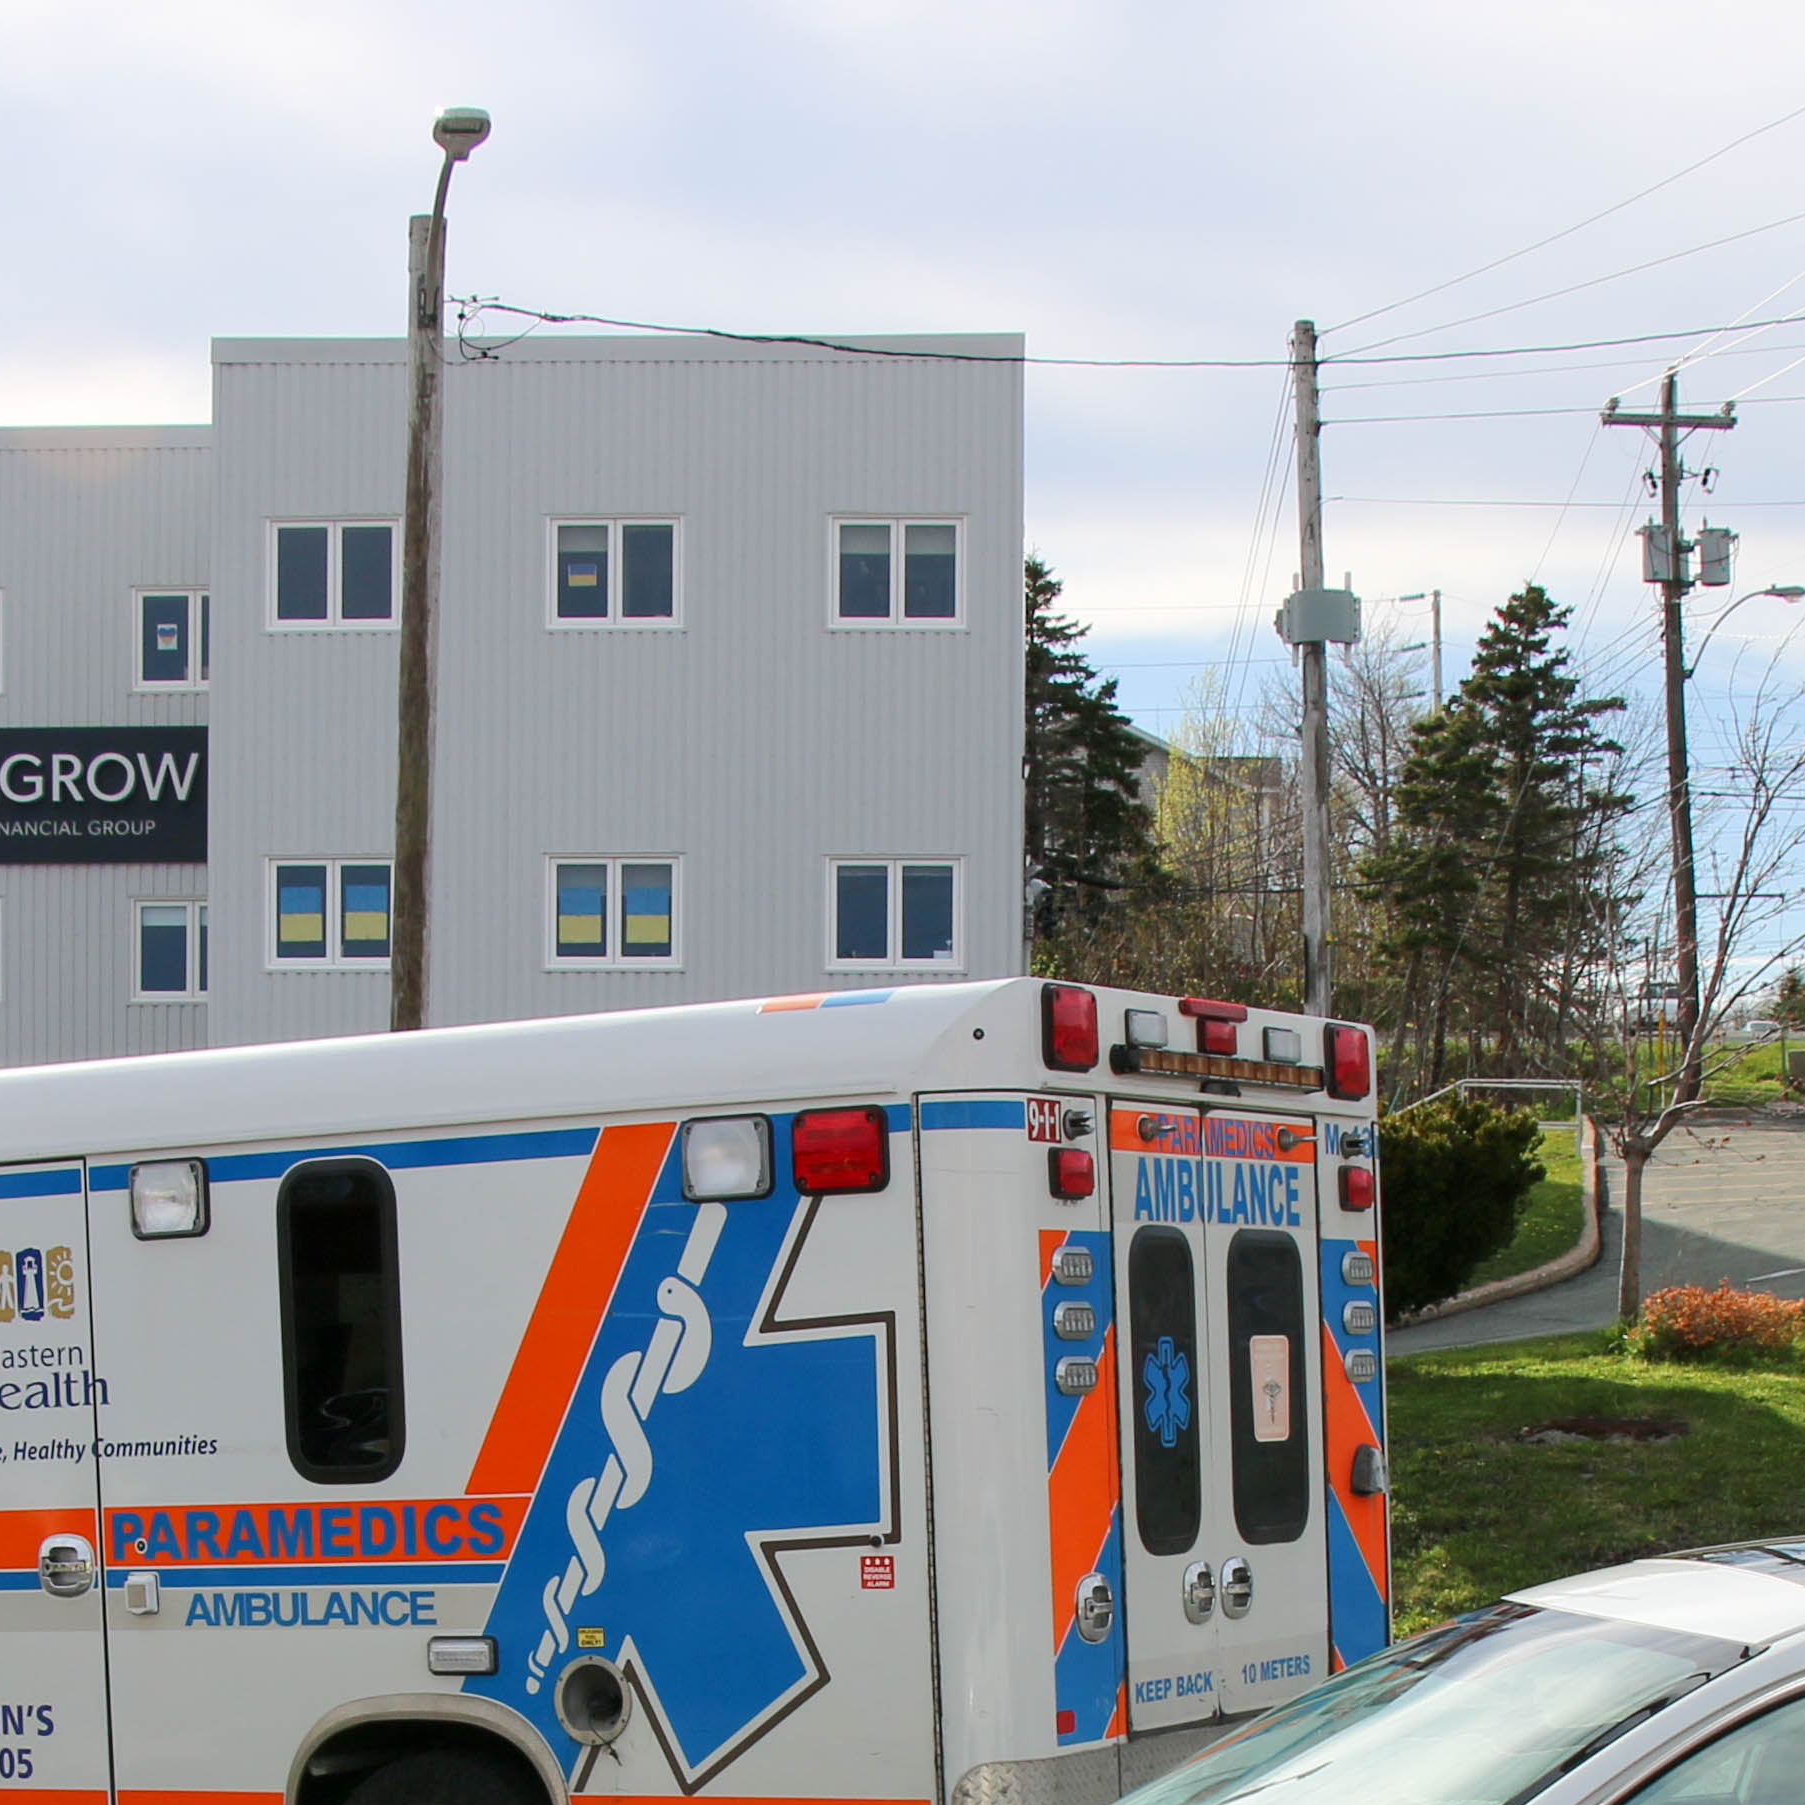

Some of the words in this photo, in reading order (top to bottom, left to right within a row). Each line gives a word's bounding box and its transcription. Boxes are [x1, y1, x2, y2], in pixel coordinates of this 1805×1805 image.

[88, 820, 156, 836] GROUP
[1029, 1101, 1060, 1140] 9-1-1
[1134, 1157, 1300, 1226] AMBULANCE
[14, 1439, 86, 1463] Healthy
[93, 1435, 218, 1459] Communities
[111, 1503, 505, 1561] PARAMEDICS
[185, 1591, 437, 1627] AMBULANCE
[1135, 1678, 1172, 1704] KEEP
[1176, 1671, 1213, 1697] BACK
[1242, 1663, 1257, 1684] 10
[1260, 1655, 1311, 1681] METERS
